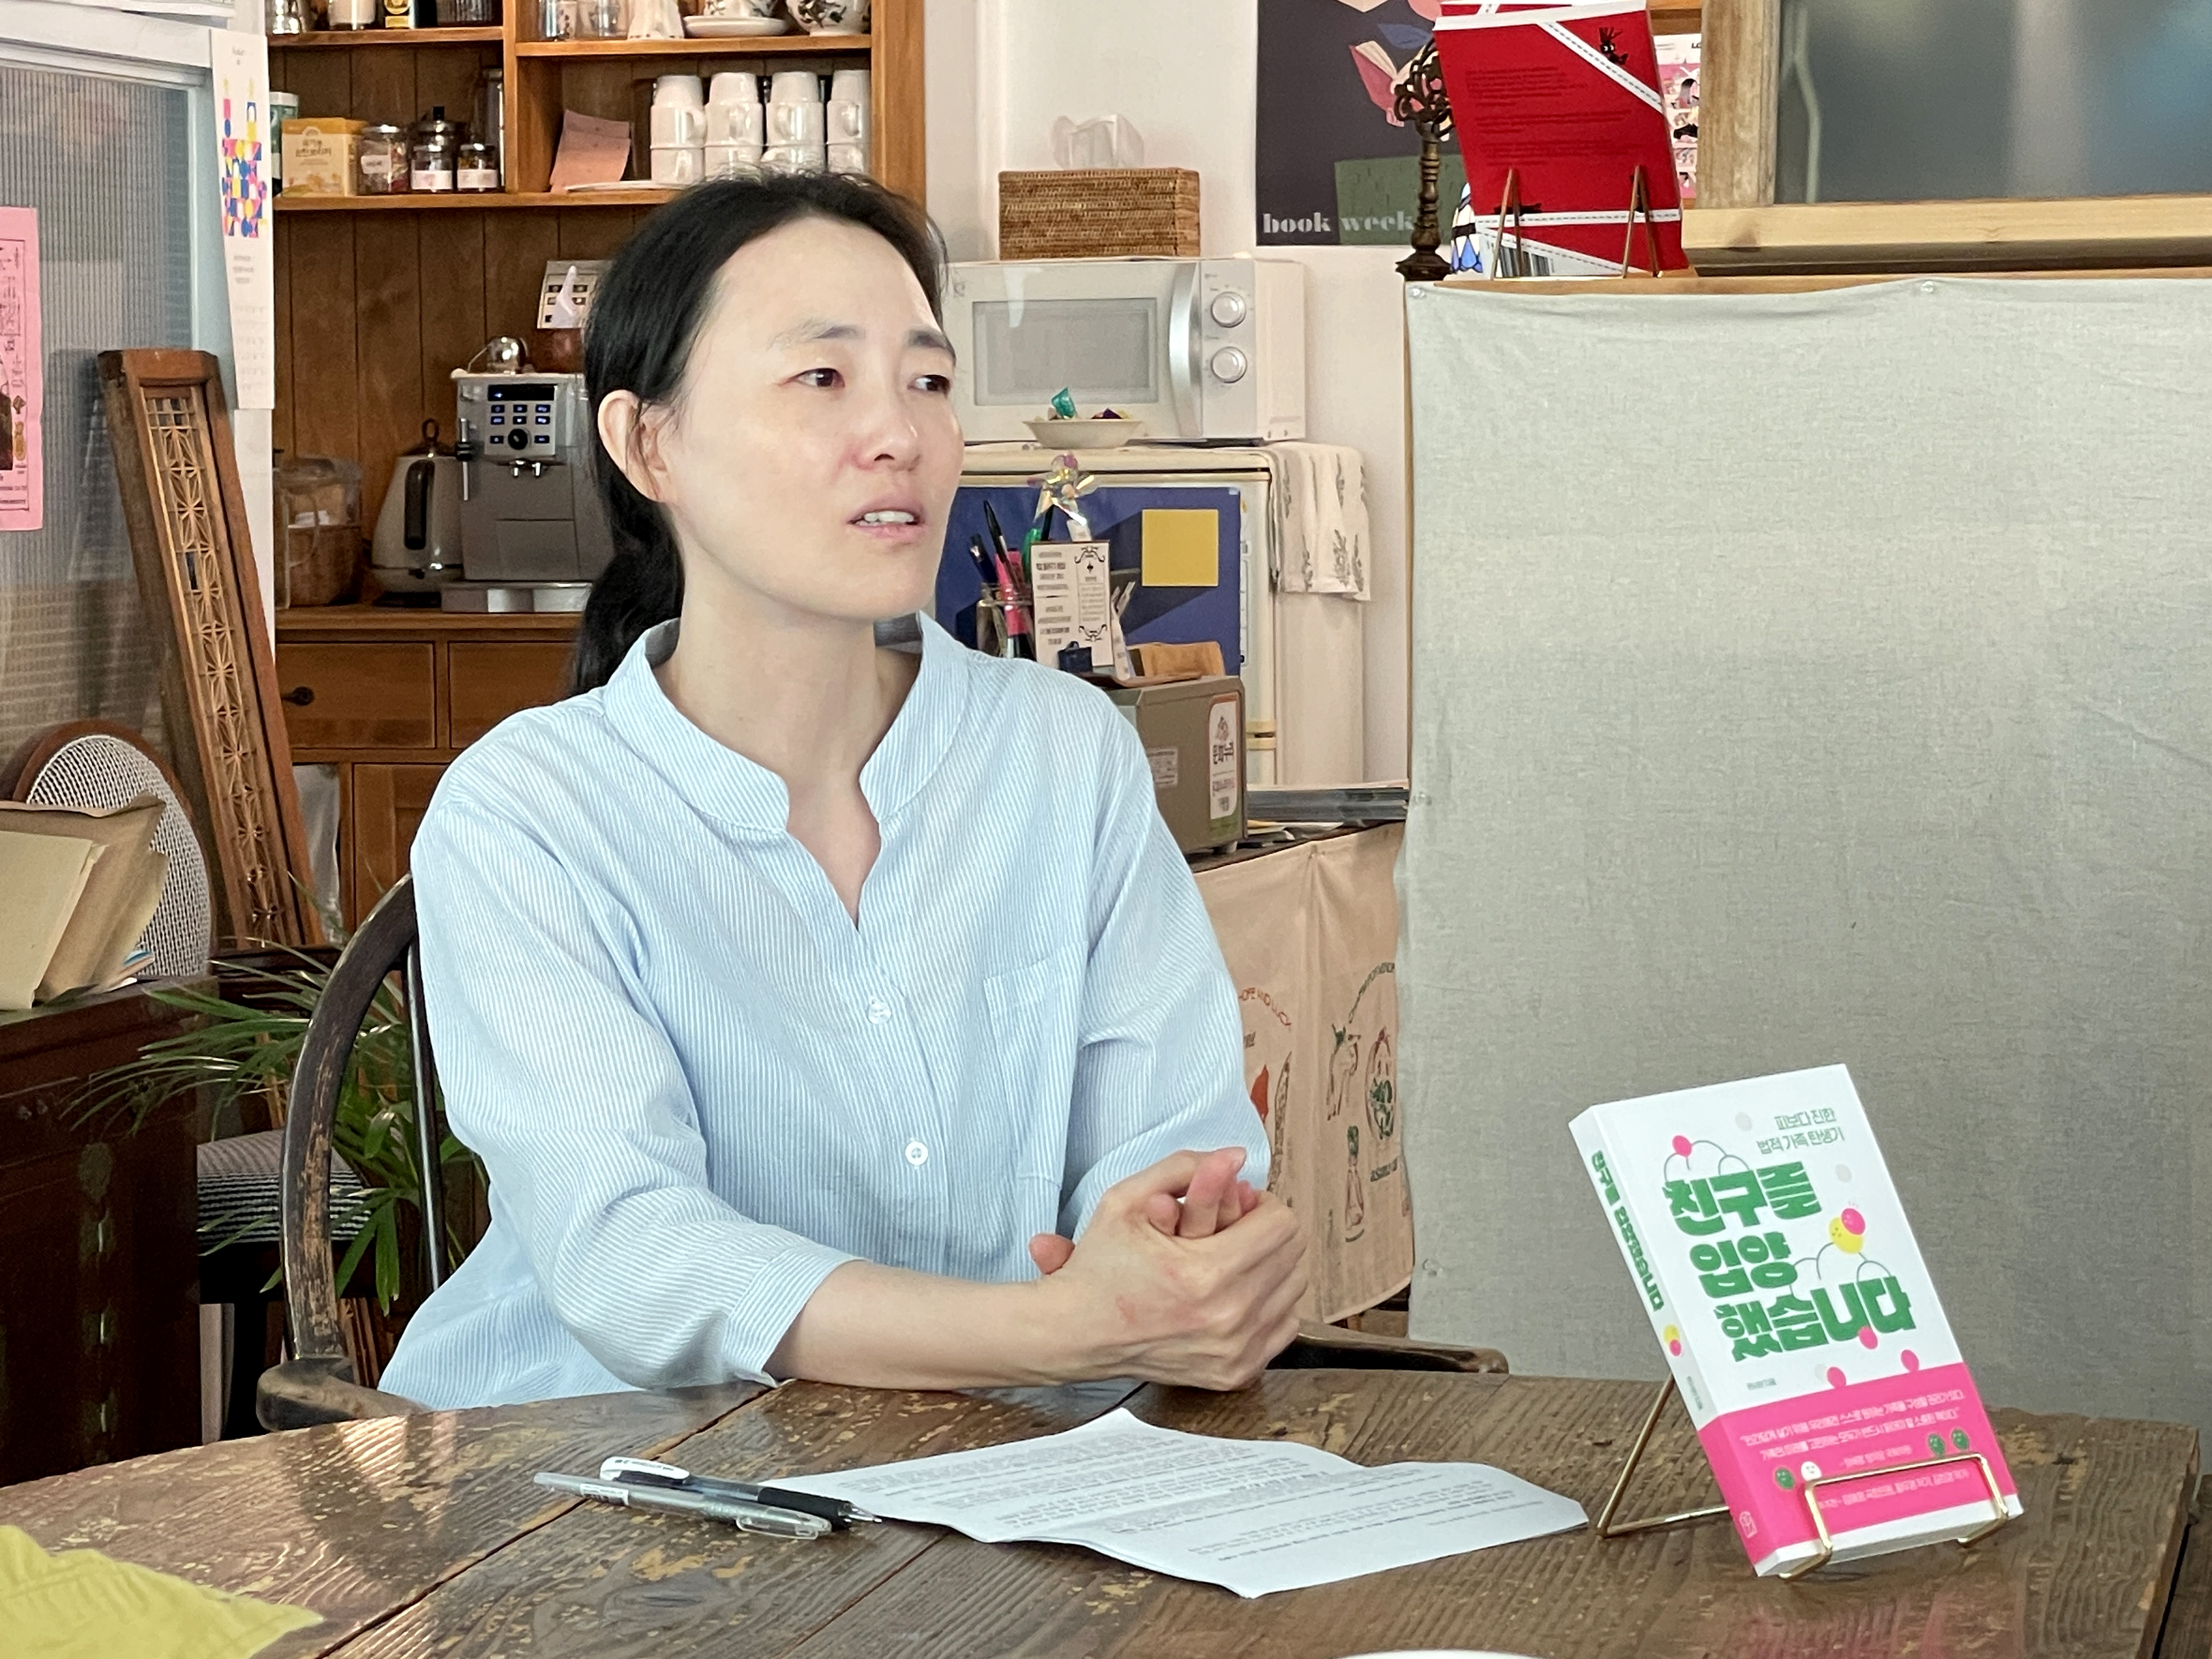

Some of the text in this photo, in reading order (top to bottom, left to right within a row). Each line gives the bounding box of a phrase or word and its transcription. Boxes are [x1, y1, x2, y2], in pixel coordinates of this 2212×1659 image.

[1263, 211, 1414, 233] book week
[1757, 1126, 1845, 1154] 법적 가족 탄생기
[1774, 1108, 1837, 1130] 피보다 진한
[1662, 1161, 1822, 1236] 친구를
[1690, 1231, 1798, 1299] 입양
[1713, 1276, 1916, 1362] 했습니다
